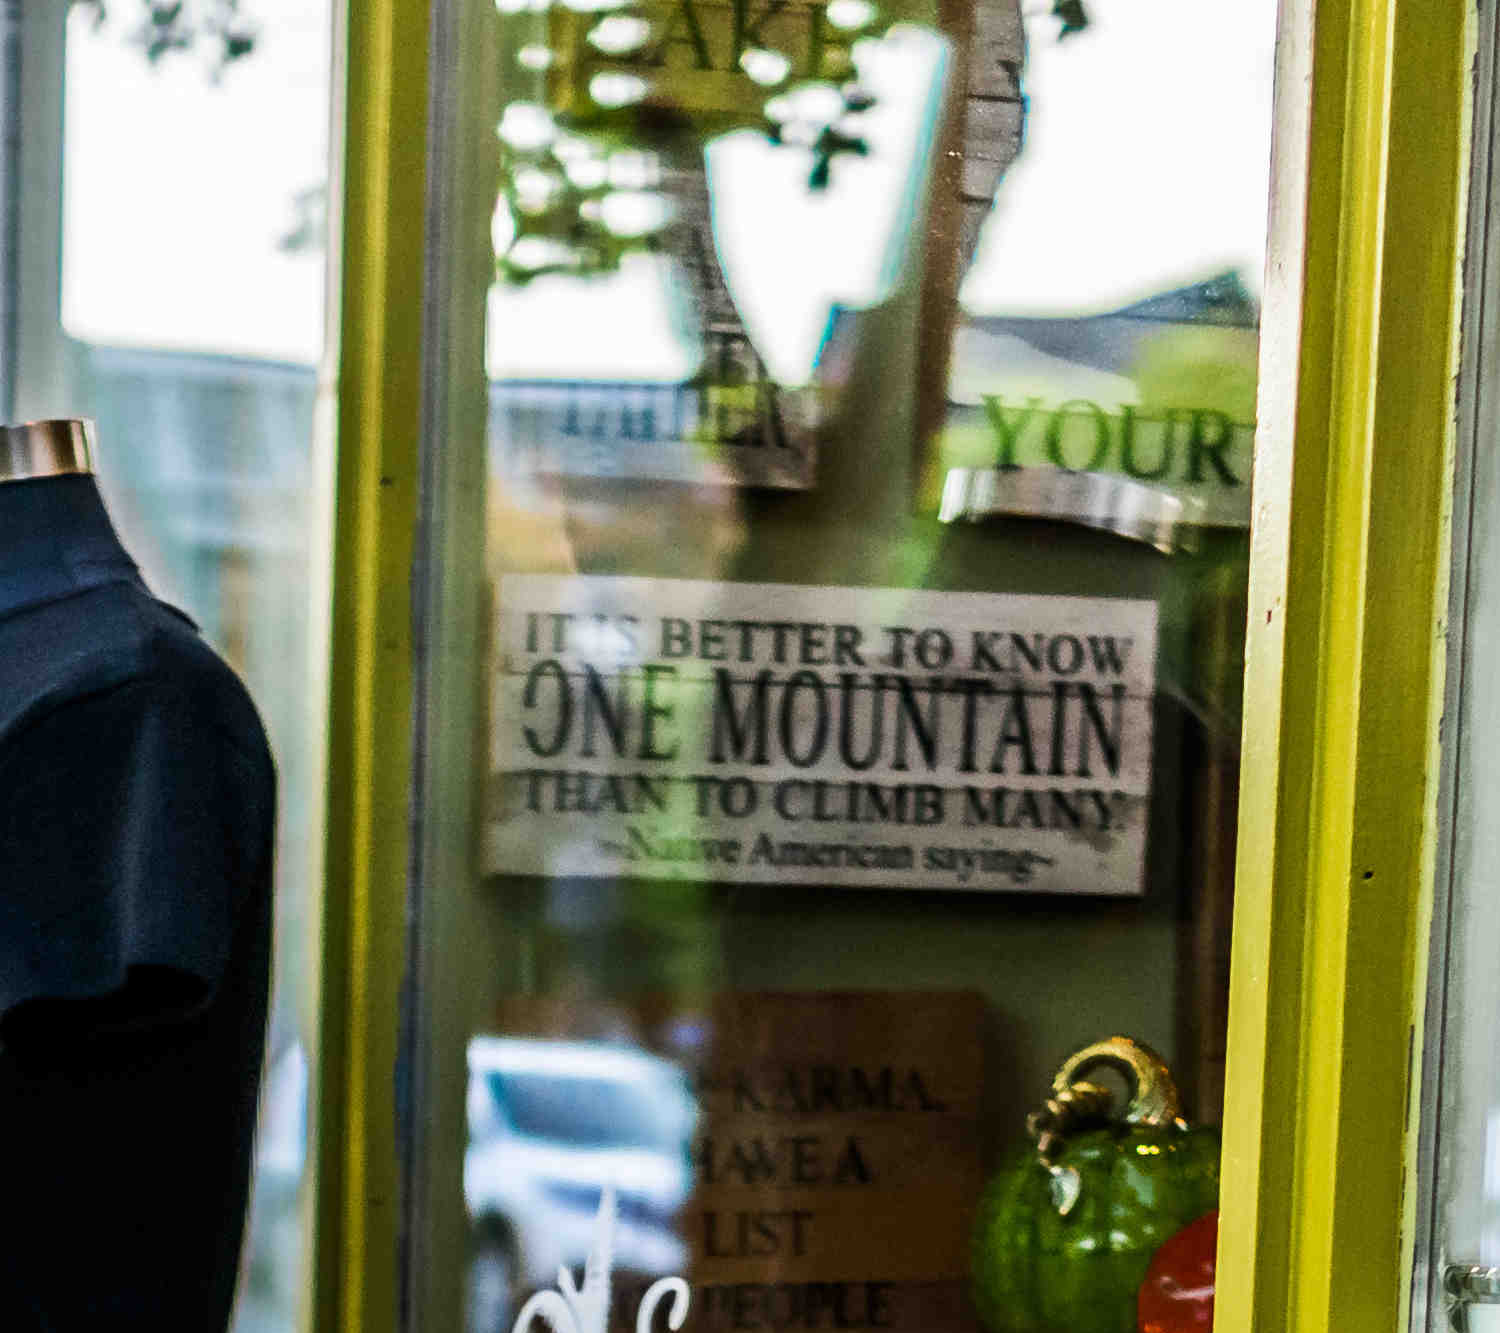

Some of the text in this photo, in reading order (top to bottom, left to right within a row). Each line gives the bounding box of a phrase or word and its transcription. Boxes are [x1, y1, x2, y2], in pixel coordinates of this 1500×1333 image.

[981, 393, 1240, 487] YOUR
[660, 617, 866, 667] BETTER
[880, 626, 953, 671] TO
[970, 630, 1132, 676] KNOW
[522, 658, 1127, 779] ONE MOUNTAIN
[524, 769, 669, 816] THAN
[692, 775, 758, 820] TO
[774, 778, 943, 826] CLIMB
[752, 832, 912, 869] American
[703, 1210, 815, 1257] LIST
